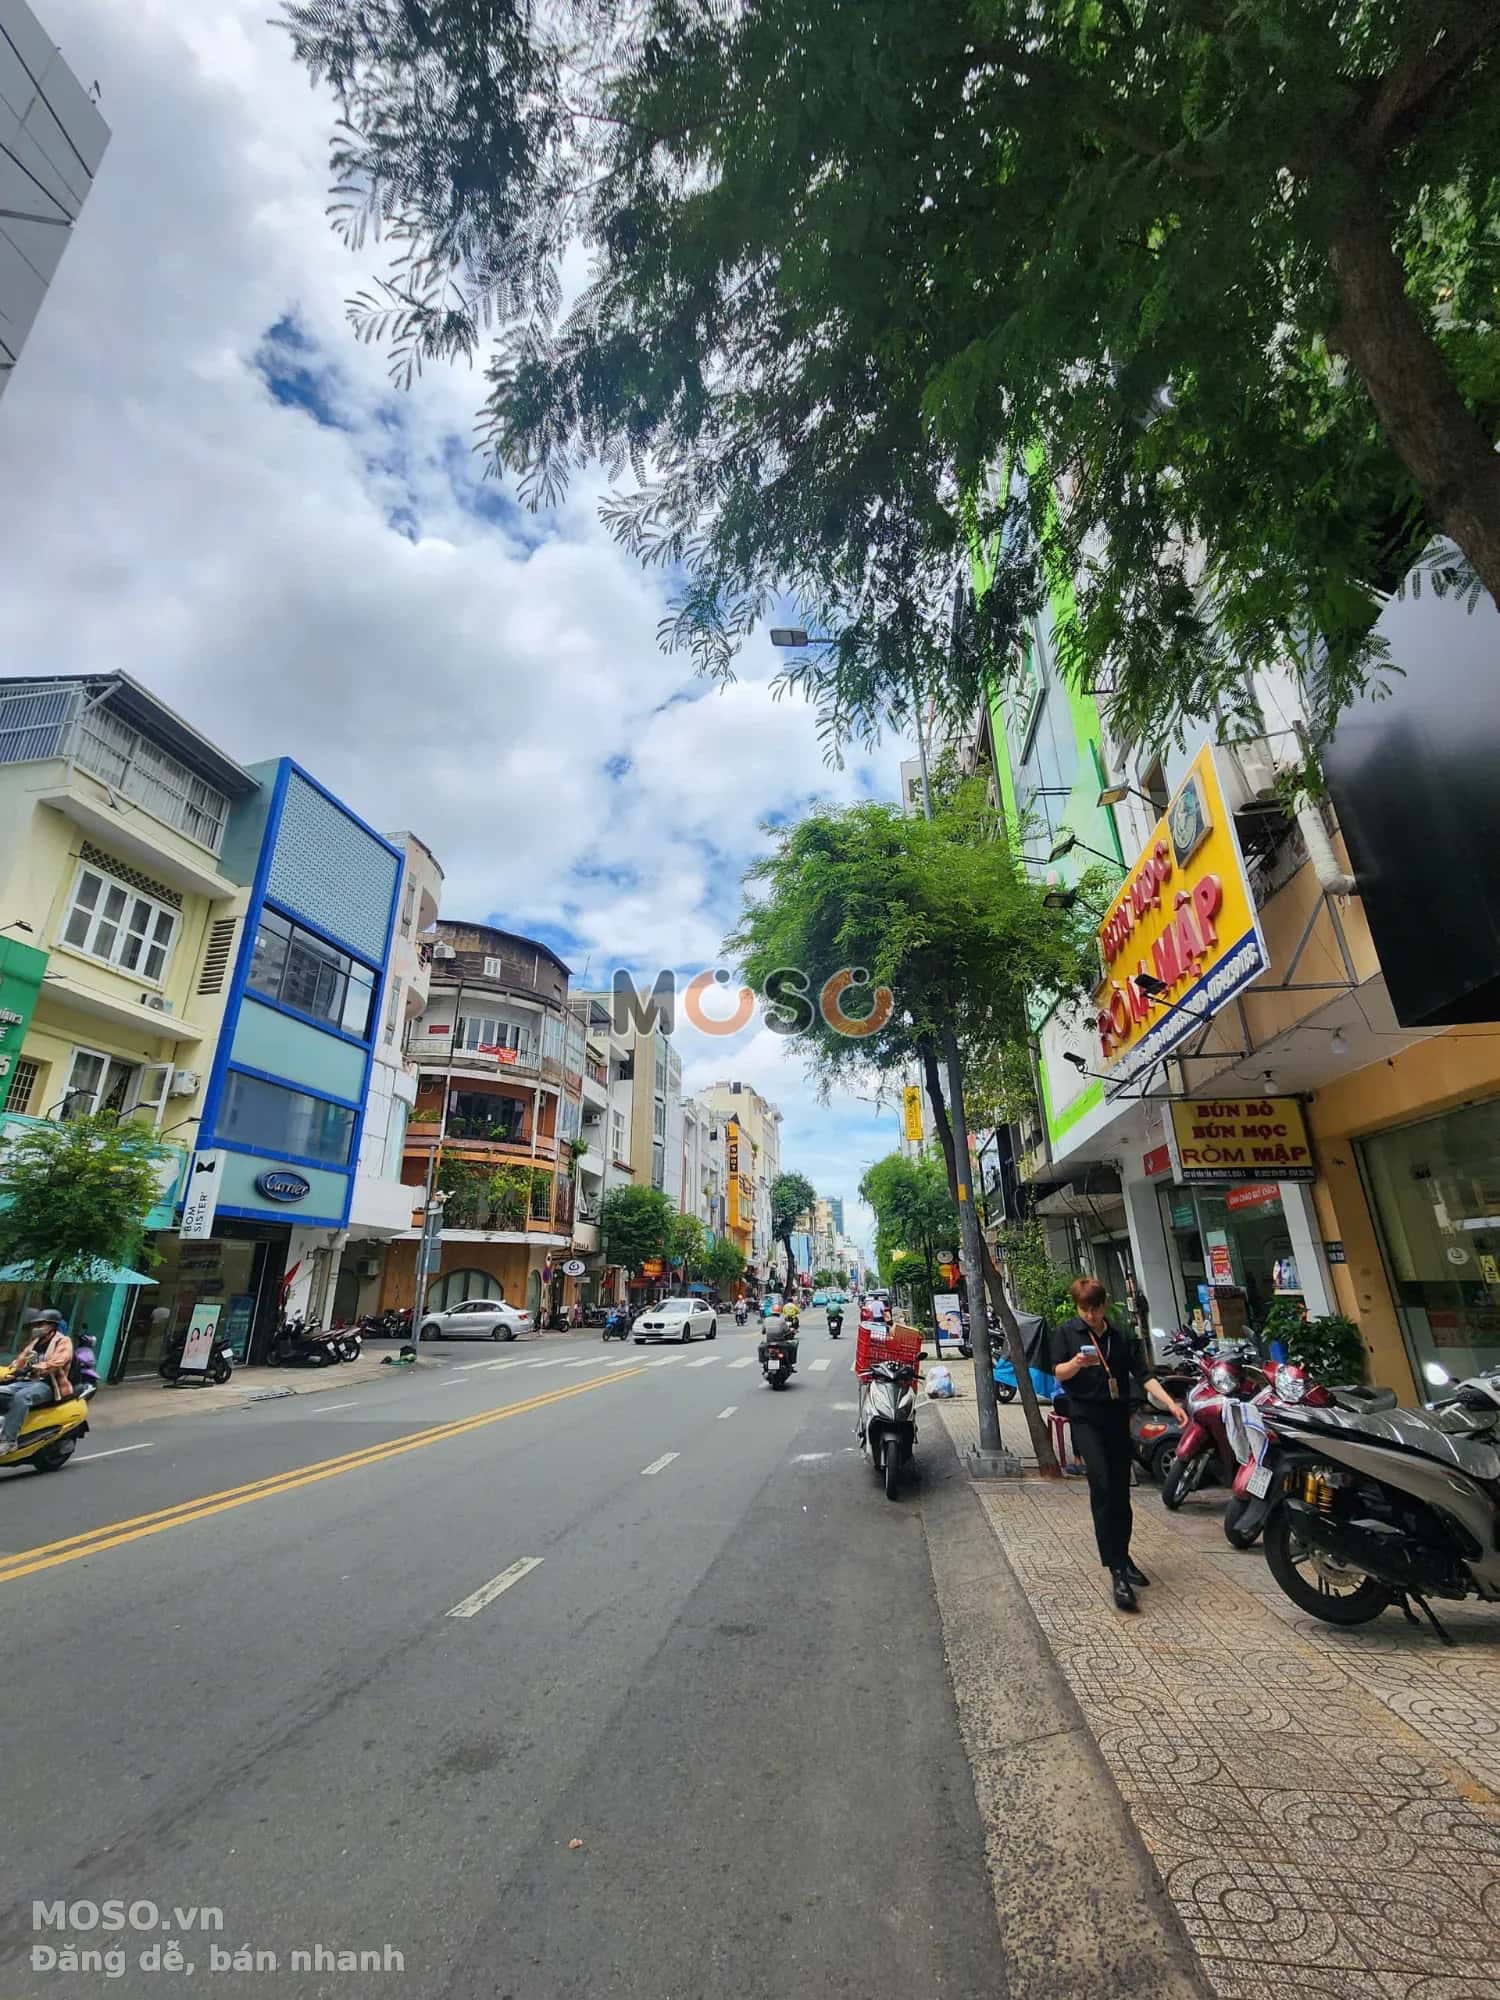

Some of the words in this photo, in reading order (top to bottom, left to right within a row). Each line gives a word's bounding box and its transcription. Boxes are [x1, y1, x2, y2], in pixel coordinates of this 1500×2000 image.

[1152, 874, 1222, 988] MẬP
[1196, 1101, 1240, 1118] BÚN
[1246, 1100, 1274, 1117] BÒ
[1192, 1122, 1236, 1139] BÚN
[1241, 1124, 1288, 1142] MỌC
[1182, 1144, 1245, 1164] RÒM
[1252, 1143, 1307, 1164] MẬP
[266, 1174, 310, 1197] Carrier
[183, 1205, 197, 1232] BOM
